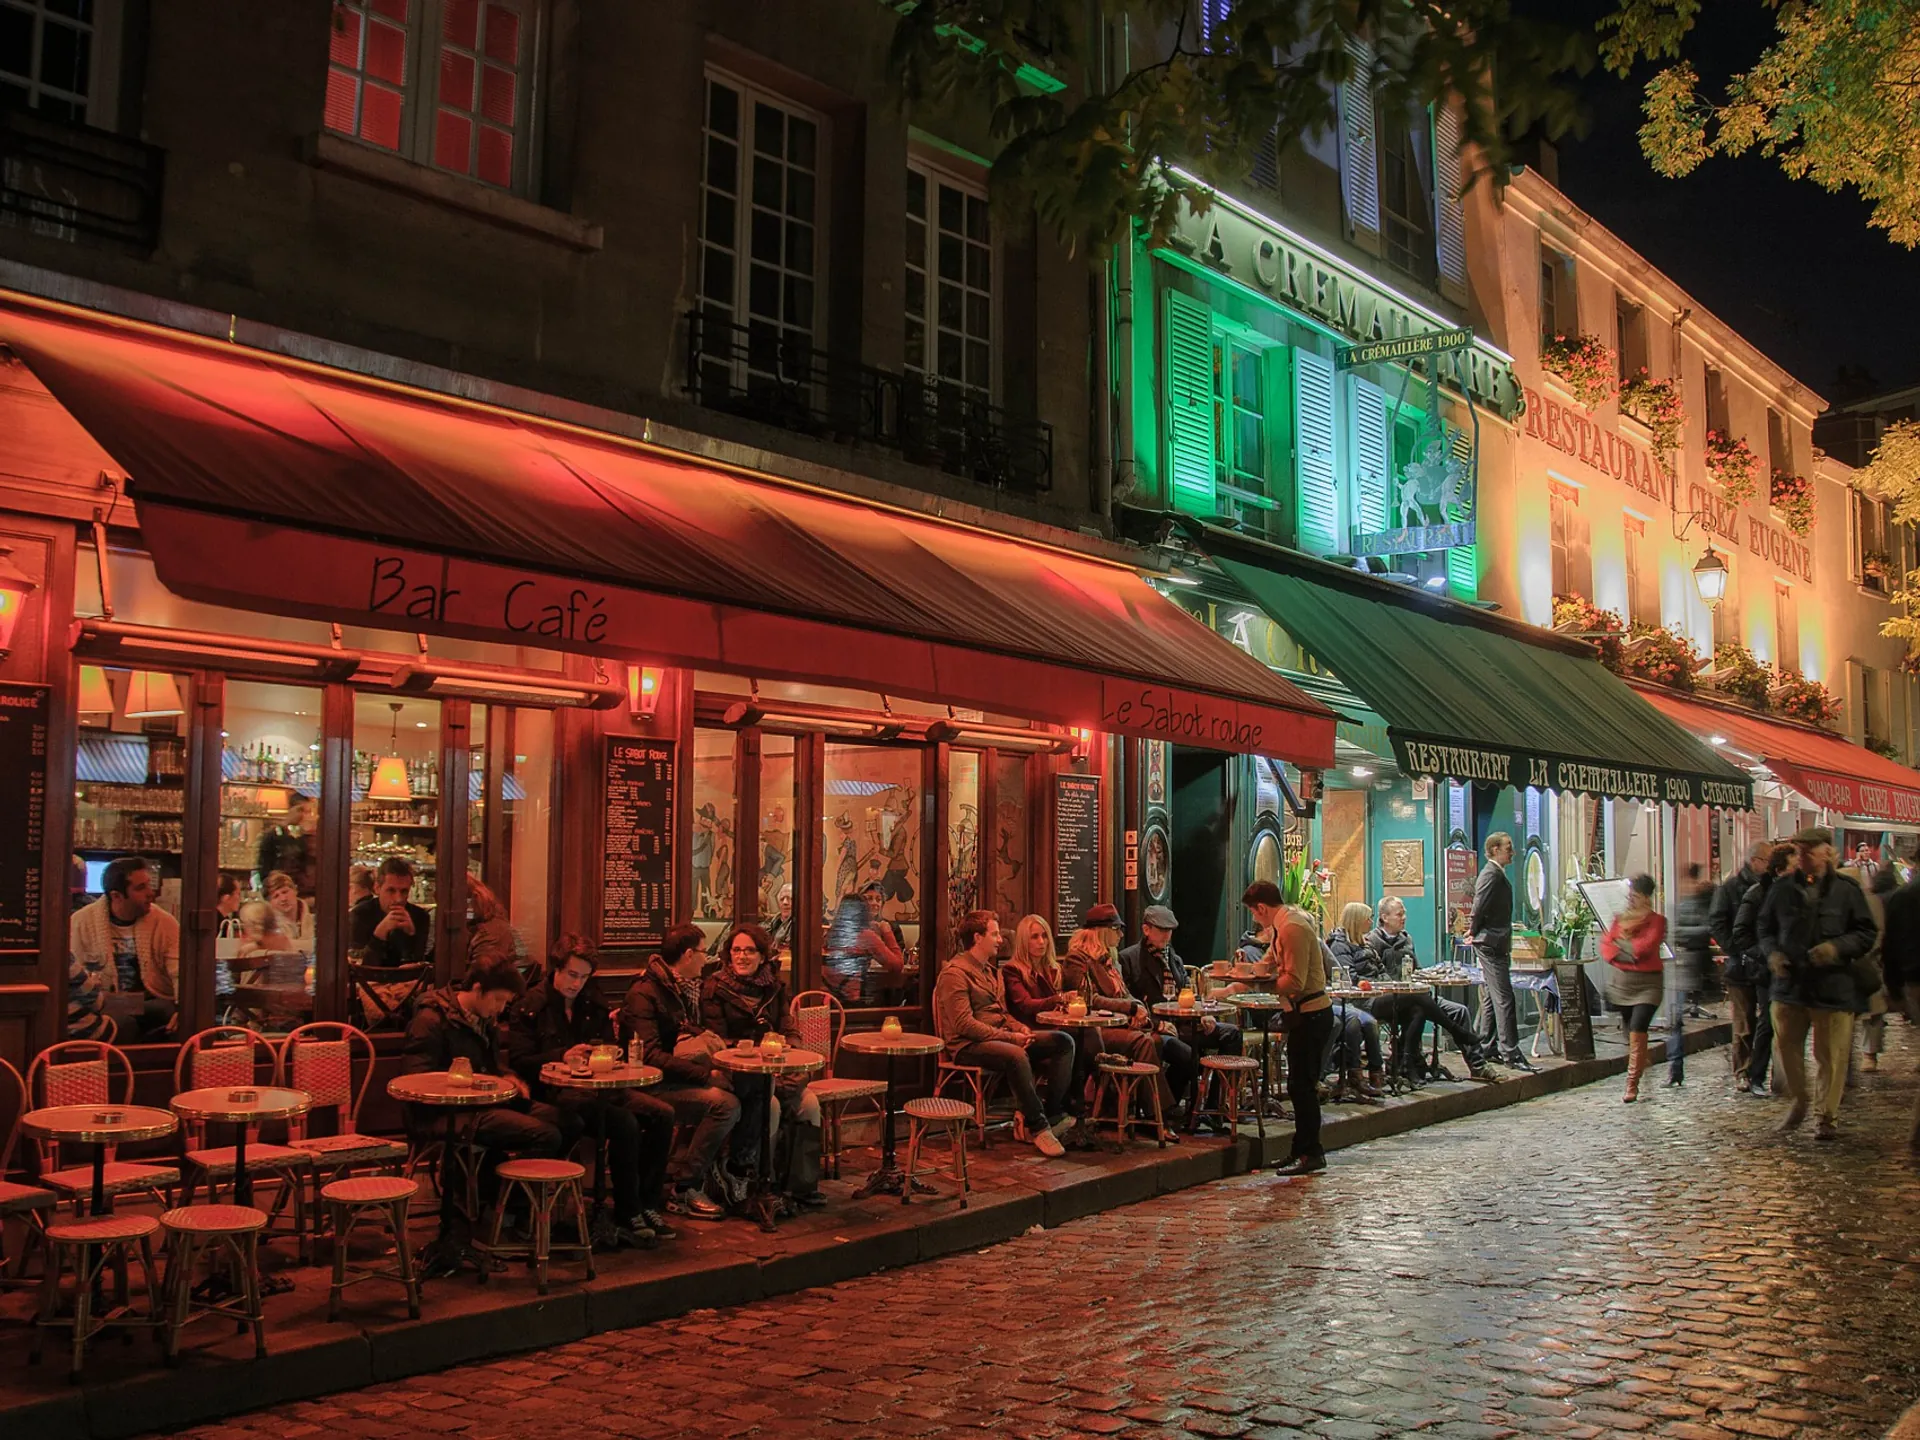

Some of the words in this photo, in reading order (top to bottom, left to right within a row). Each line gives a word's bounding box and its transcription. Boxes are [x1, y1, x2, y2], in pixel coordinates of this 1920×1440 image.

[1343, 351, 1357, 363] LA
[1438, 332, 1465, 348] 1900
[1688, 482, 1740, 545] CHEZ
[1748, 516, 1812, 583] EUGÈNE
[369, 556, 461, 622] Bar
[503, 580, 609, 643] Café
[1100, 680, 1132, 723] Le
[1140, 691, 1204, 737] Sabot
[1211, 715, 1263, 747] rouge
[613, 746, 624, 758] LE
[625, 747, 647, 760] SABOT
[648, 749, 668, 761] ROUGE
[1404, 740, 1511, 782] RESTAURANT
[1529, 757, 1550, 787] LA
[1557, 762, 1659, 798] CREMAILLERE
[1665, 778, 1691, 802] 1900
[1701, 780, 1748, 806] CABARET
[1807, 779, 1852, 807] PIANO-BAR
[1860, 784, 1890, 814] CHEZ
